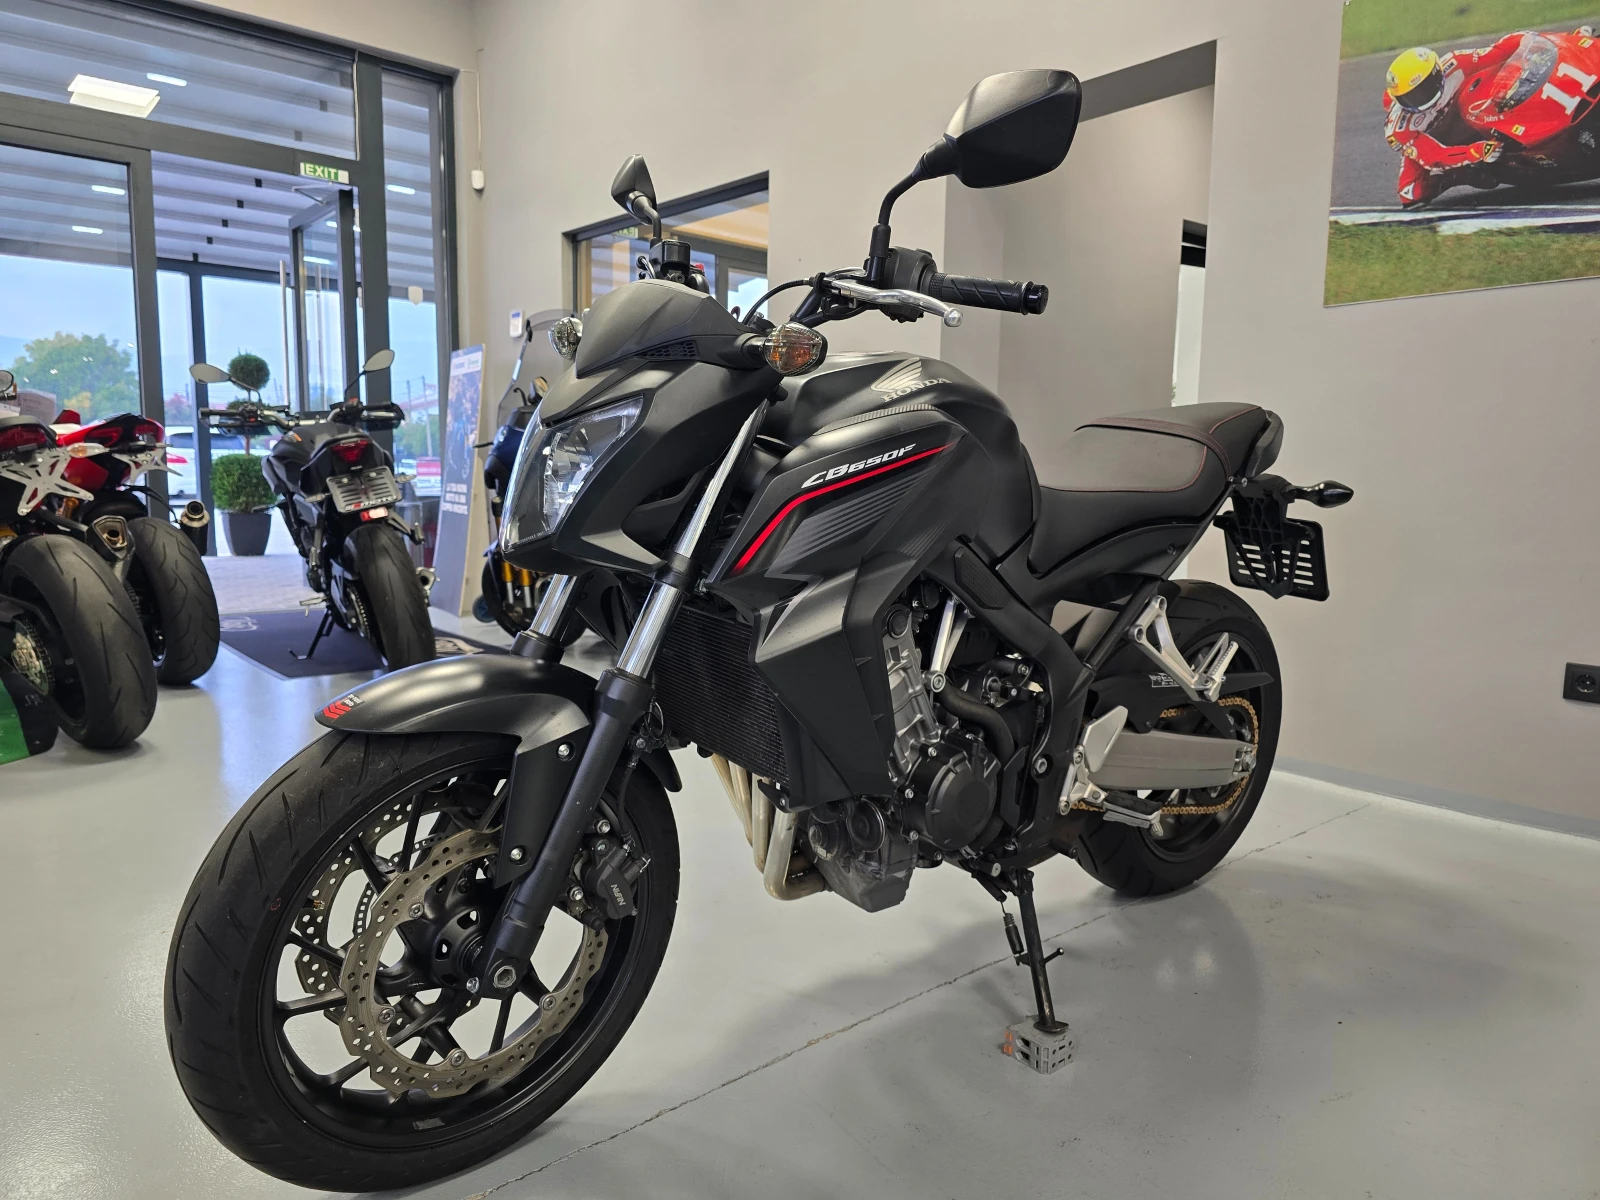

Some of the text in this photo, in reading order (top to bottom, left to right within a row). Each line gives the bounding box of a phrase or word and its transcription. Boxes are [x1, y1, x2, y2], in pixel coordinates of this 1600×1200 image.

[1541, 62, 1598, 116] 11
[305, 163, 338, 181] EXIT
[881, 377, 953, 402] HONDA
[801, 443, 917, 489] CB650F
